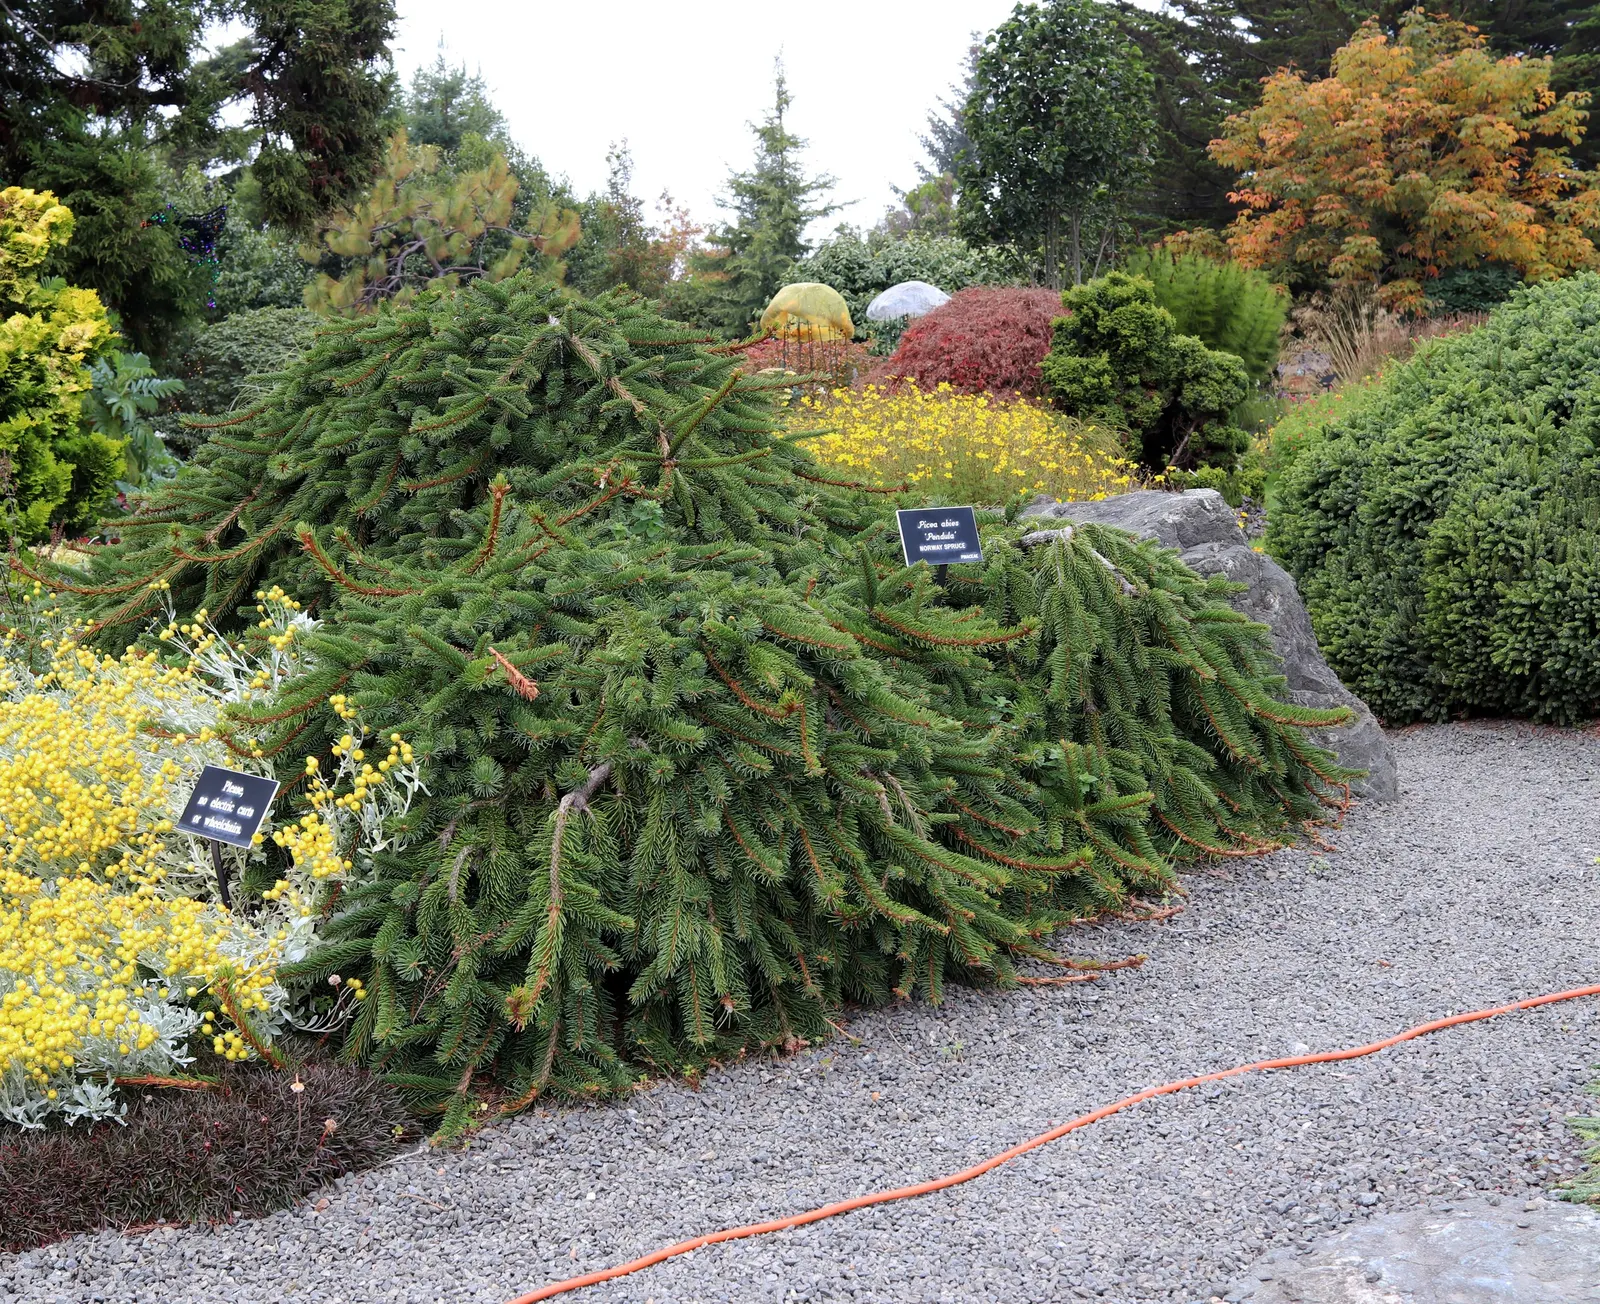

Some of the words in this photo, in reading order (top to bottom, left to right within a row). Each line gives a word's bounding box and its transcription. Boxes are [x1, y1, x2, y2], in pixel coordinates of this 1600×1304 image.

[917, 520, 938, 529] Picea
[941, 519, 959, 527] abies
[919, 544, 943, 552] NORWAY
[943, 542, 966, 550] SPRUCE
[222, 780, 244, 798] Please,
[197, 796, 208, 805] no
[210, 797, 235, 812] electric
[237, 806, 255, 817] carts
[191, 815, 202, 824] or
